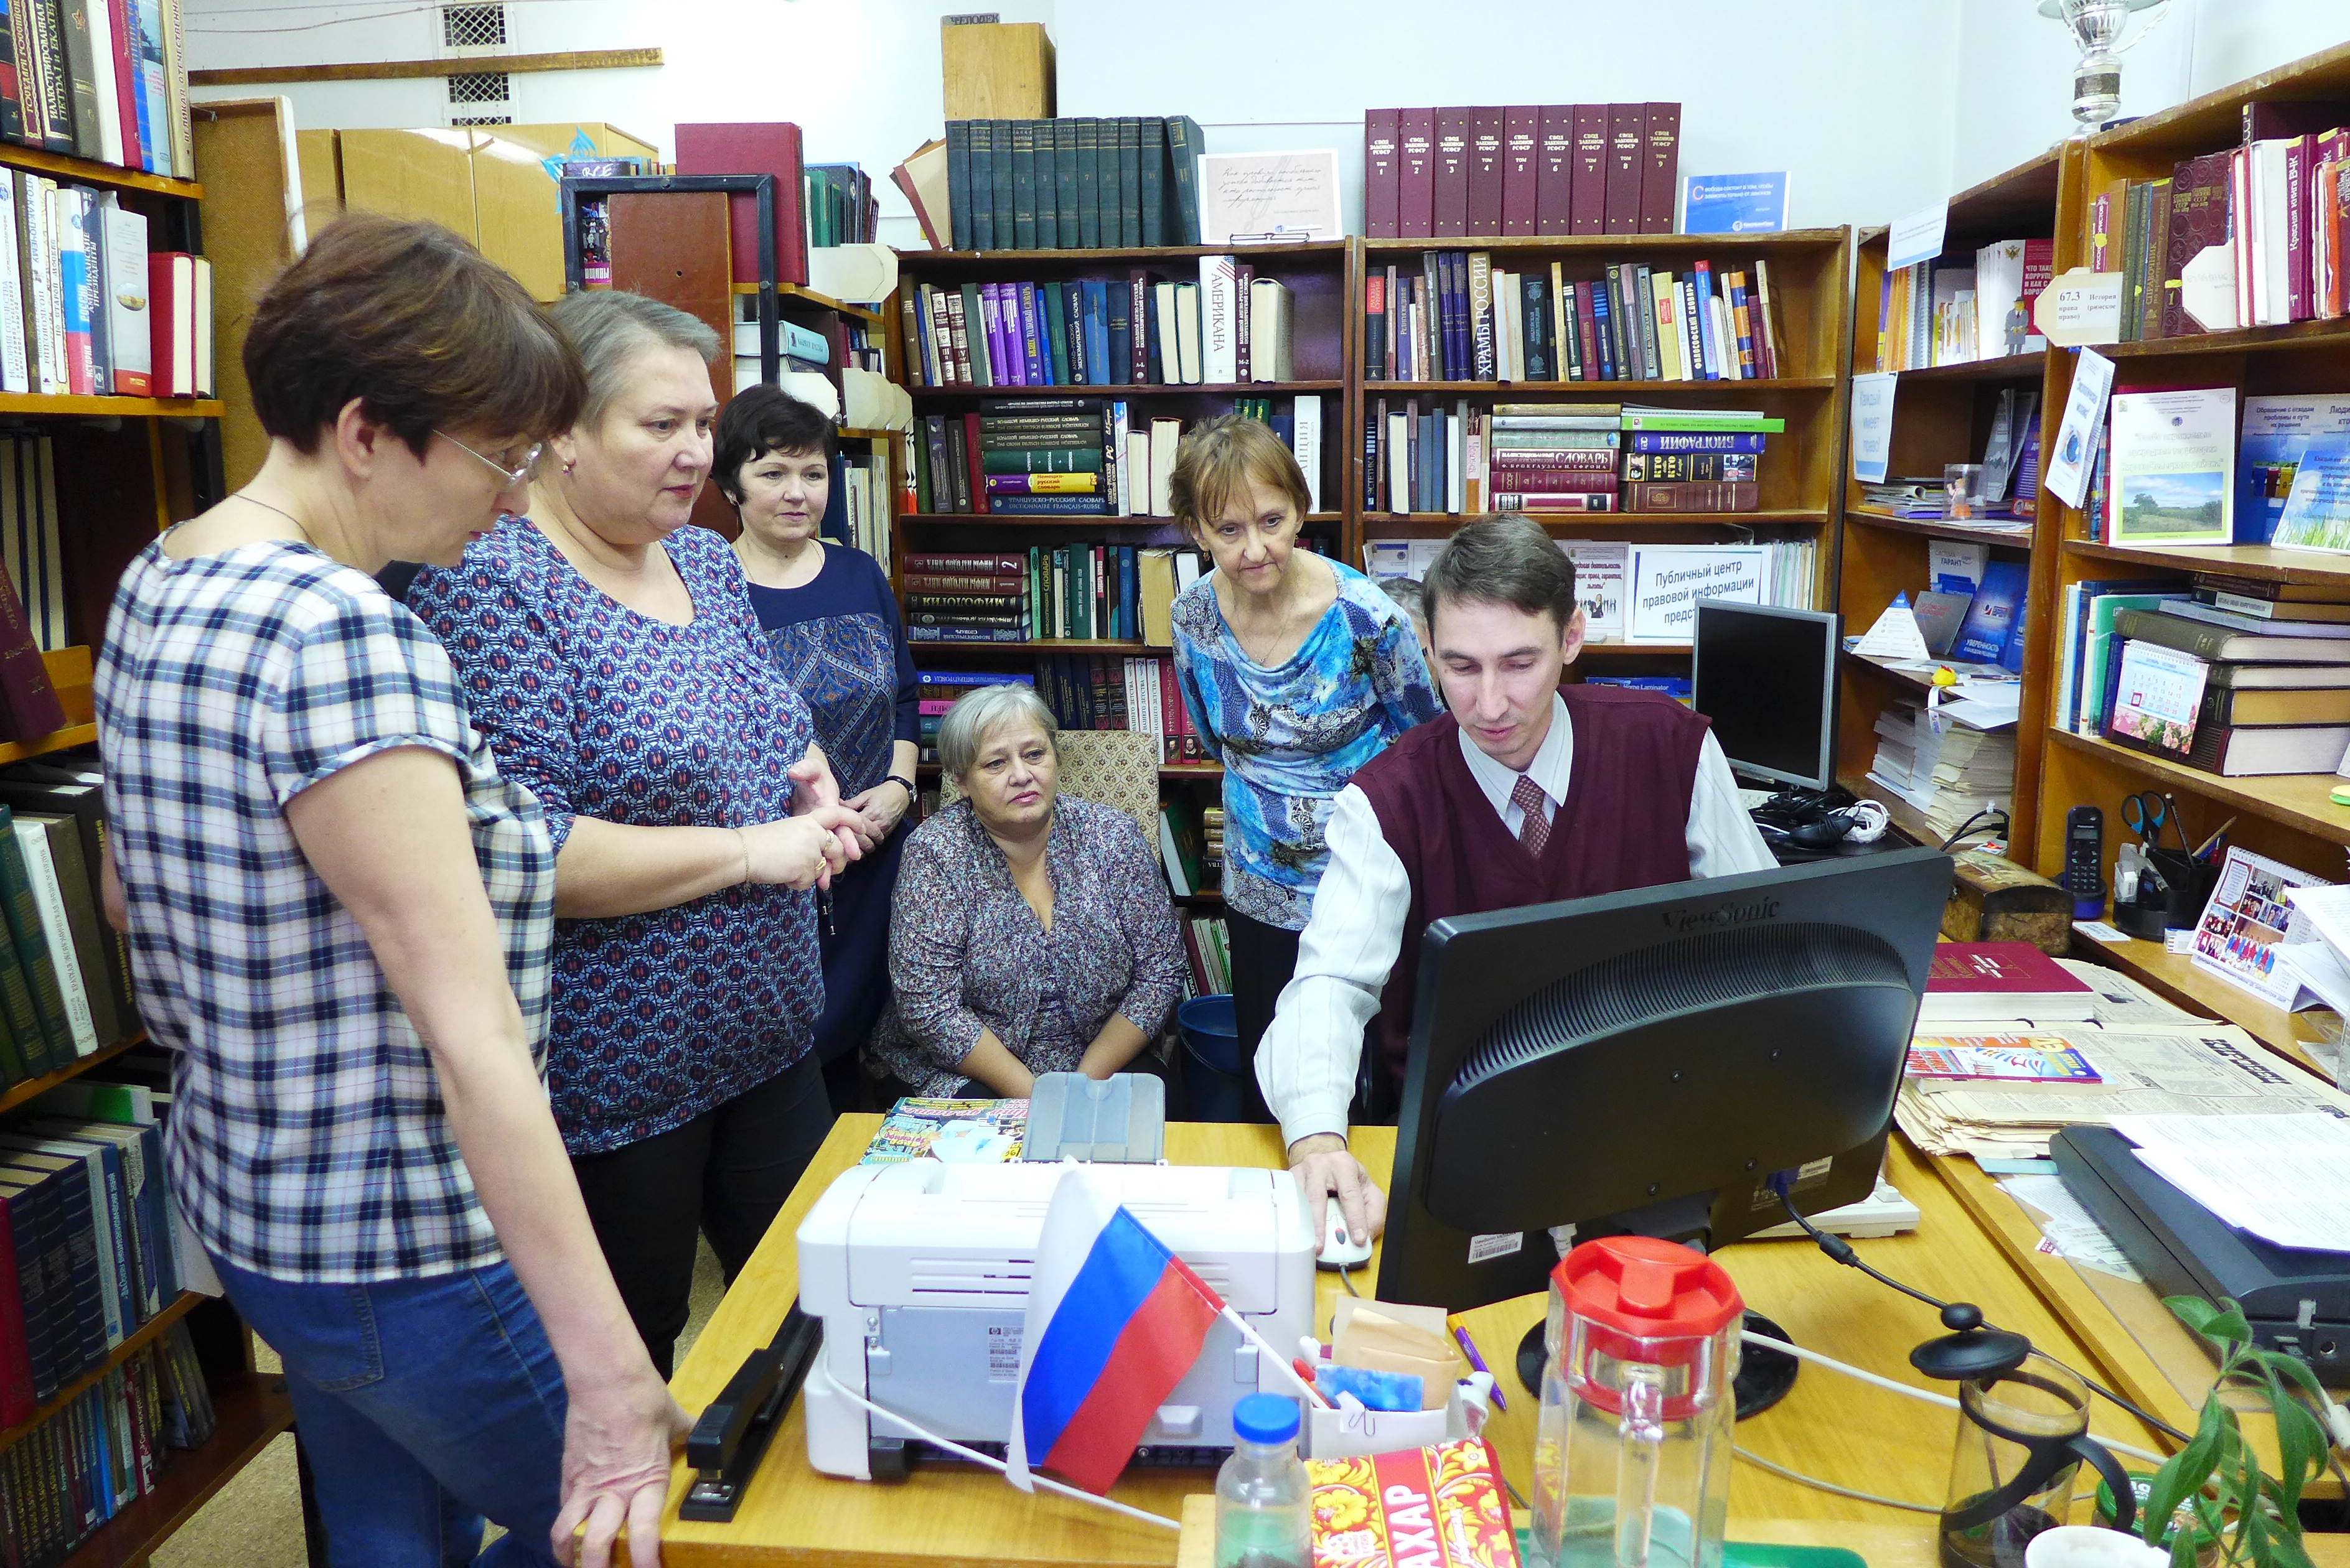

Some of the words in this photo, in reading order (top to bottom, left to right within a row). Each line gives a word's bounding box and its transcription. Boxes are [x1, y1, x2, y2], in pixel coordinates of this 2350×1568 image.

[36, 2, 59, 119] ИЛЛЮСТРИРОВАННАЯ
[54, 75, 68, 121] ПЕТРА
[179, 88, 190, 143] ВЕЛИКАЯ
[2289, 155, 2299, 179] ВЧК
[2290, 180, 2298, 207] книга
[2290, 207, 2298, 251] Красная
[83, 232, 95, 314] АМЕРИКАНСКИЕ
[90, 241, 100, 307] ПРЕЗИДЕНТЫ
[1472, 256, 1490, 320] РОССИИ
[2145, 242, 2157, 304] СПРАВОЧНИК
[77, 284, 90, 322] РОССИИ
[1211, 273, 1225, 352] АМЕРИКАНА
[1685, 282, 1697, 315] СЛОВАРЬ
[2059, 291, 2081, 301] 67.3
[1069, 324, 1077, 370] АНГЛО-РУССКИЙ
[1476, 322, 1493, 376] ХРАМЫ
[1687, 315, 1702, 370] ФИЛОСОФСКИЙ
[83, 345, 94, 377] ИСТОРИЯ
[1556, 452, 1609, 464] СЛОВАРЬ
[1660, 436, 1734, 450] БИОГРАФИИ
[1654, 456, 1662, 478] КТО
[945, 558, 972, 571] НАРОДОВ
[1001, 561, 1017, 569] 2
[1655, 563, 1711, 589] Публичный
[1714, 561, 1742, 577] центр
[1940, 558, 1962, 566] ГАРАНТ
[942, 576, 968, 590] НАРОДОВ
[1642, 587, 1689, 610] правовой
[1692, 578, 1754, 599] информации
[922, 596, 1006, 608] МИФОЛОГИЯ
[1965, 638, 2000, 652] УВЕРЕННОСТЬ
[1662, 896, 1779, 932] ViewSonic
[1384, 1485, 1442, 1568] АХАР
